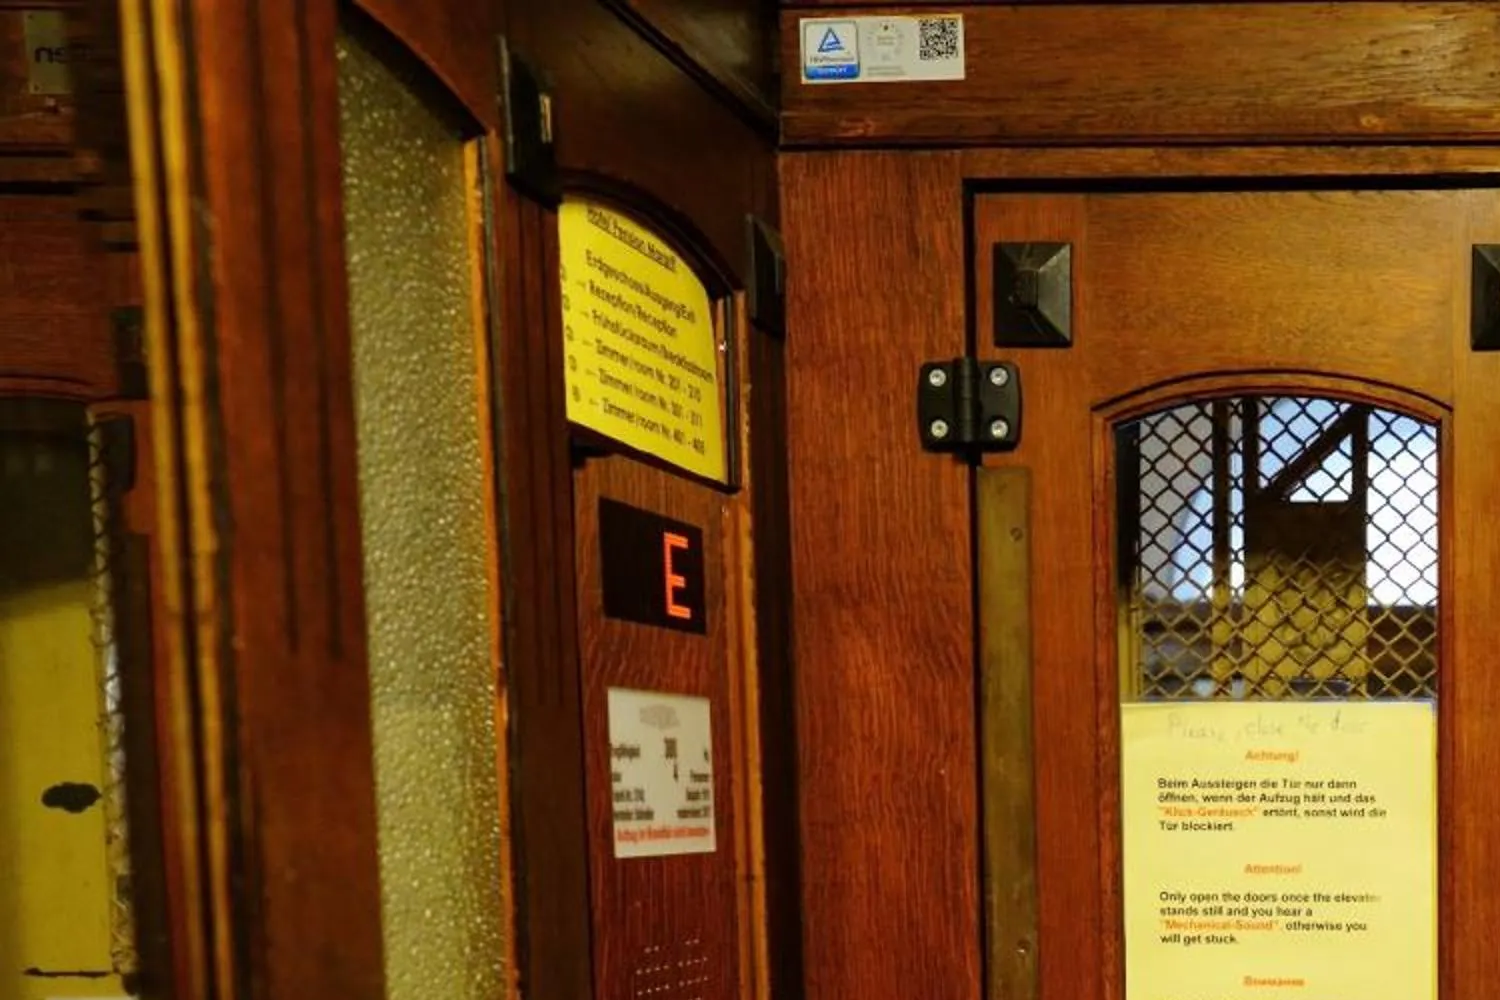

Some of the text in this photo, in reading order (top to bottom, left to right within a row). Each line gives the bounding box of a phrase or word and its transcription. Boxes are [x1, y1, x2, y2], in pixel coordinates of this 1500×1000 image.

[663, 531, 692, 620] E
[1158, 778, 1188, 789] Beim
[1191, 778, 1257, 791] Aussteigen
[1260, 779, 1278, 789] die
[1304, 780, 1323, 789] nur
[1327, 779, 1357, 789] dann
[1202, 794, 1233, 803] wenn
[1236, 793, 1256, 803] der
[1259, 793, 1301, 805] Aufzug
[1303, 793, 1325, 803] hält
[1328, 793, 1351, 803] und
[1354, 793, 1376, 803] das
[1303, 807, 1337, 817] sonst
[1340, 807, 1365, 817] wird
[1368, 808, 1387, 817] die
[1160, 820, 1178, 831] Tür
[1159, 891, 1186, 903] Only
[1189, 893, 1219, 903] open
[1221, 892, 1240, 903] the
[1243, 892, 1278, 903] doors
[1281, 894, 1310, 903] once
[1313, 892, 1331, 903] the
[1159, 906, 1198, 916] stands
[1202, 906, 1223, 916] still
[1226, 906, 1249, 916] and
[1251, 908, 1273, 918] you
[1275, 906, 1303, 916] hear
[1285, 920, 1343, 931] otherwise
[1346, 922, 1367, 933] you
[1160, 933, 1181, 943] will
[1183, 934, 1202, 946] get
